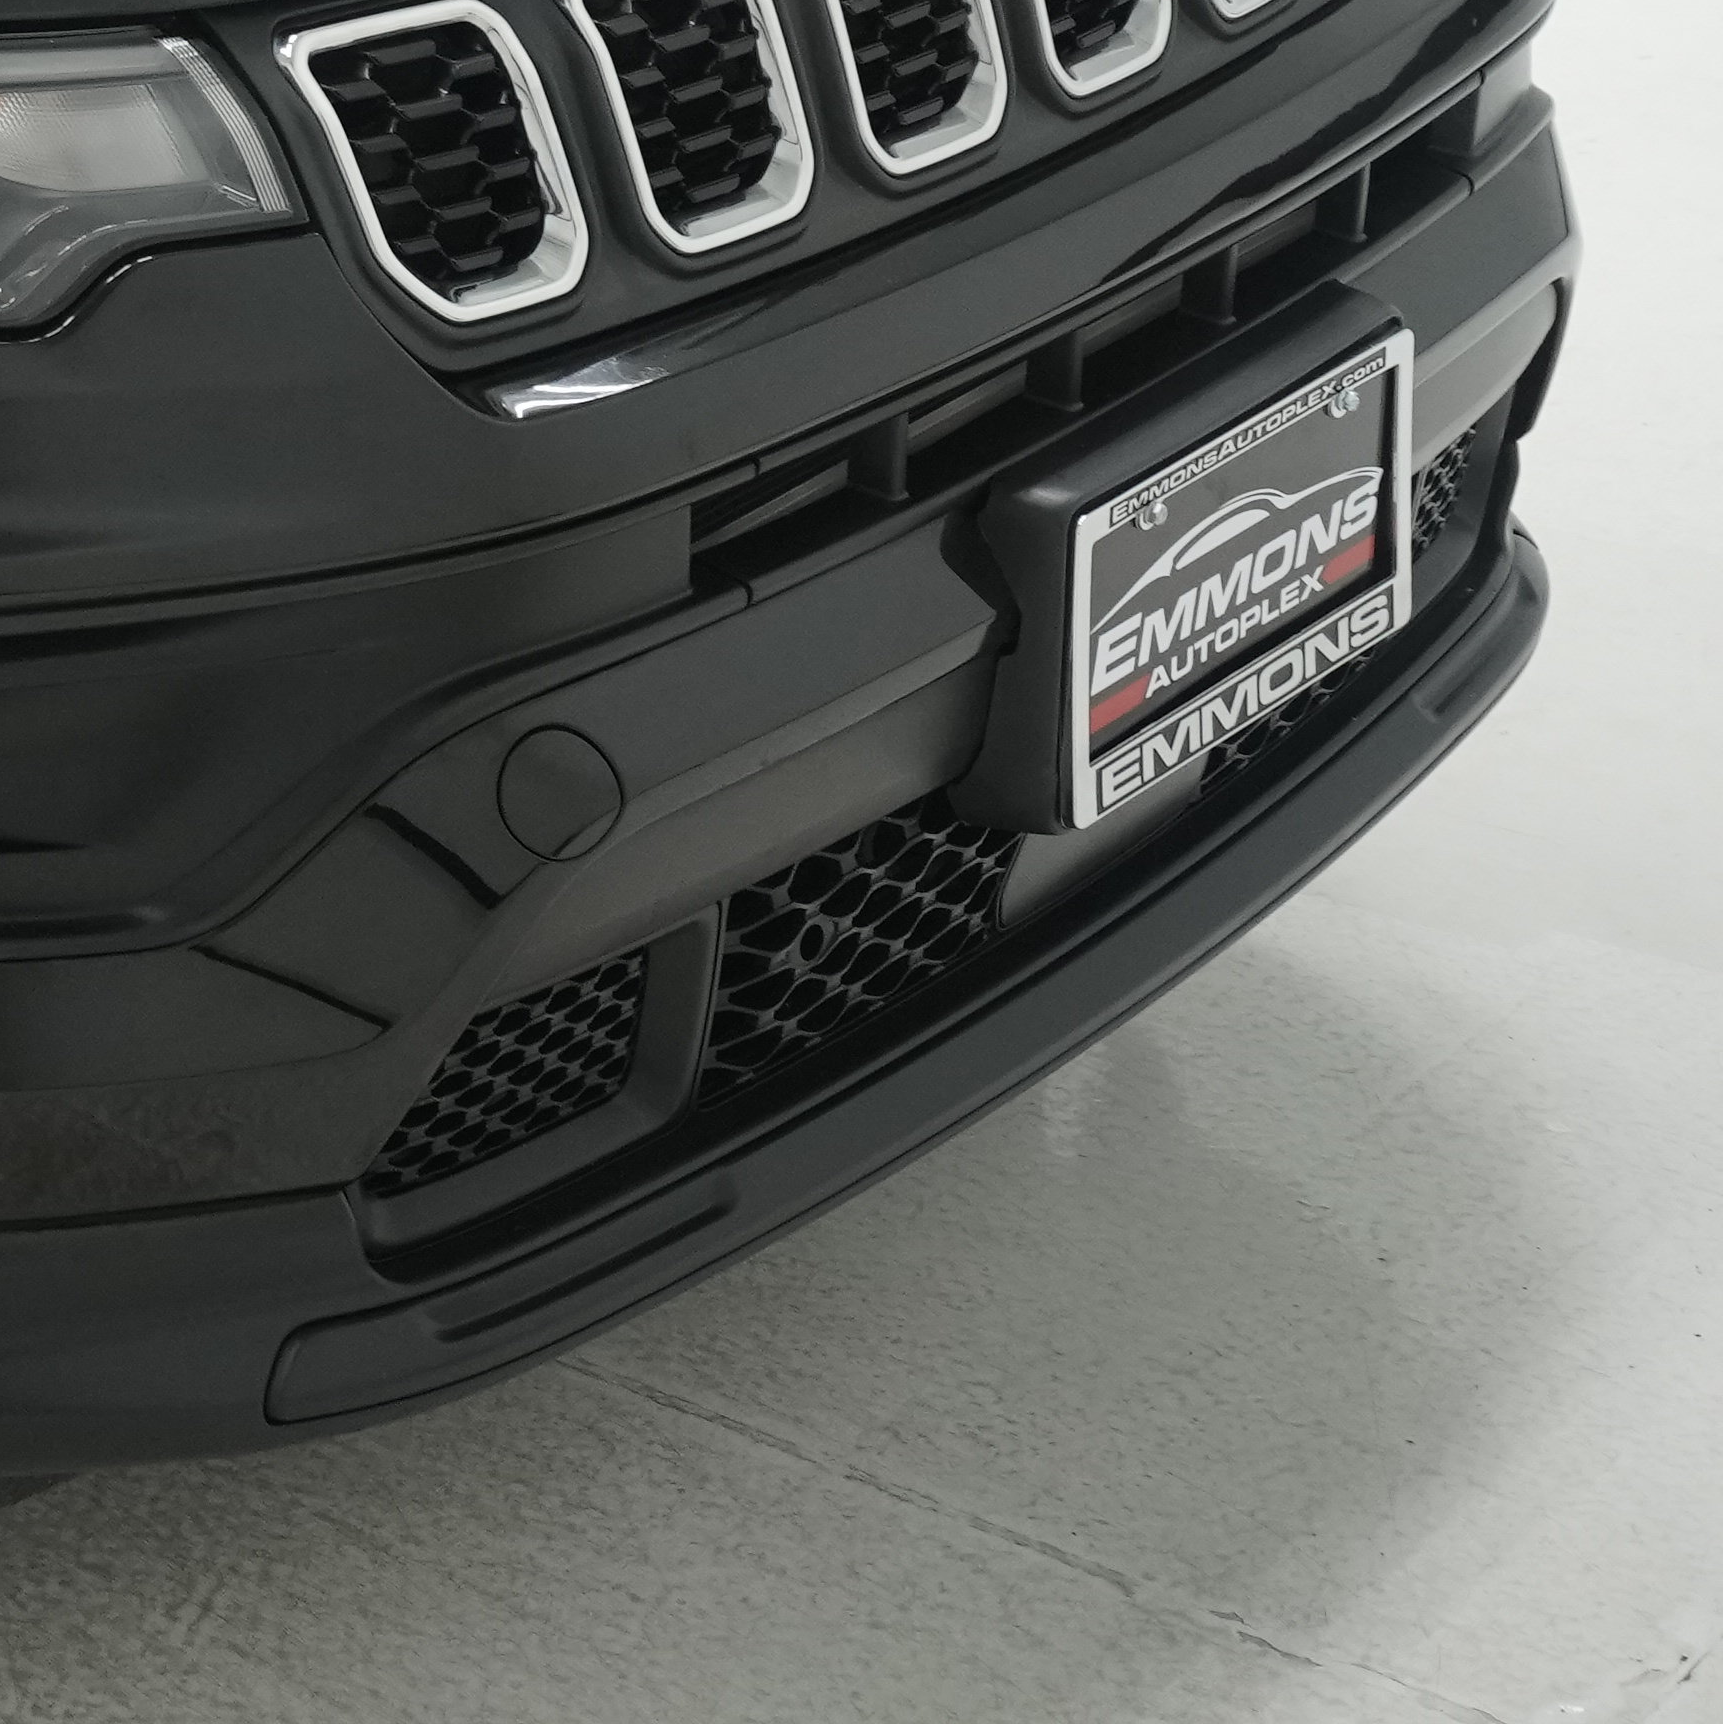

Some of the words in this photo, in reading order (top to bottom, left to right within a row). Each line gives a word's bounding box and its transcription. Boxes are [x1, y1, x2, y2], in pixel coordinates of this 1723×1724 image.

[1091, 484, 1379, 697] EMMONS
[1145, 565, 1327, 699] AUTOPLEX
[1101, 594, 1392, 807] EMMONS
